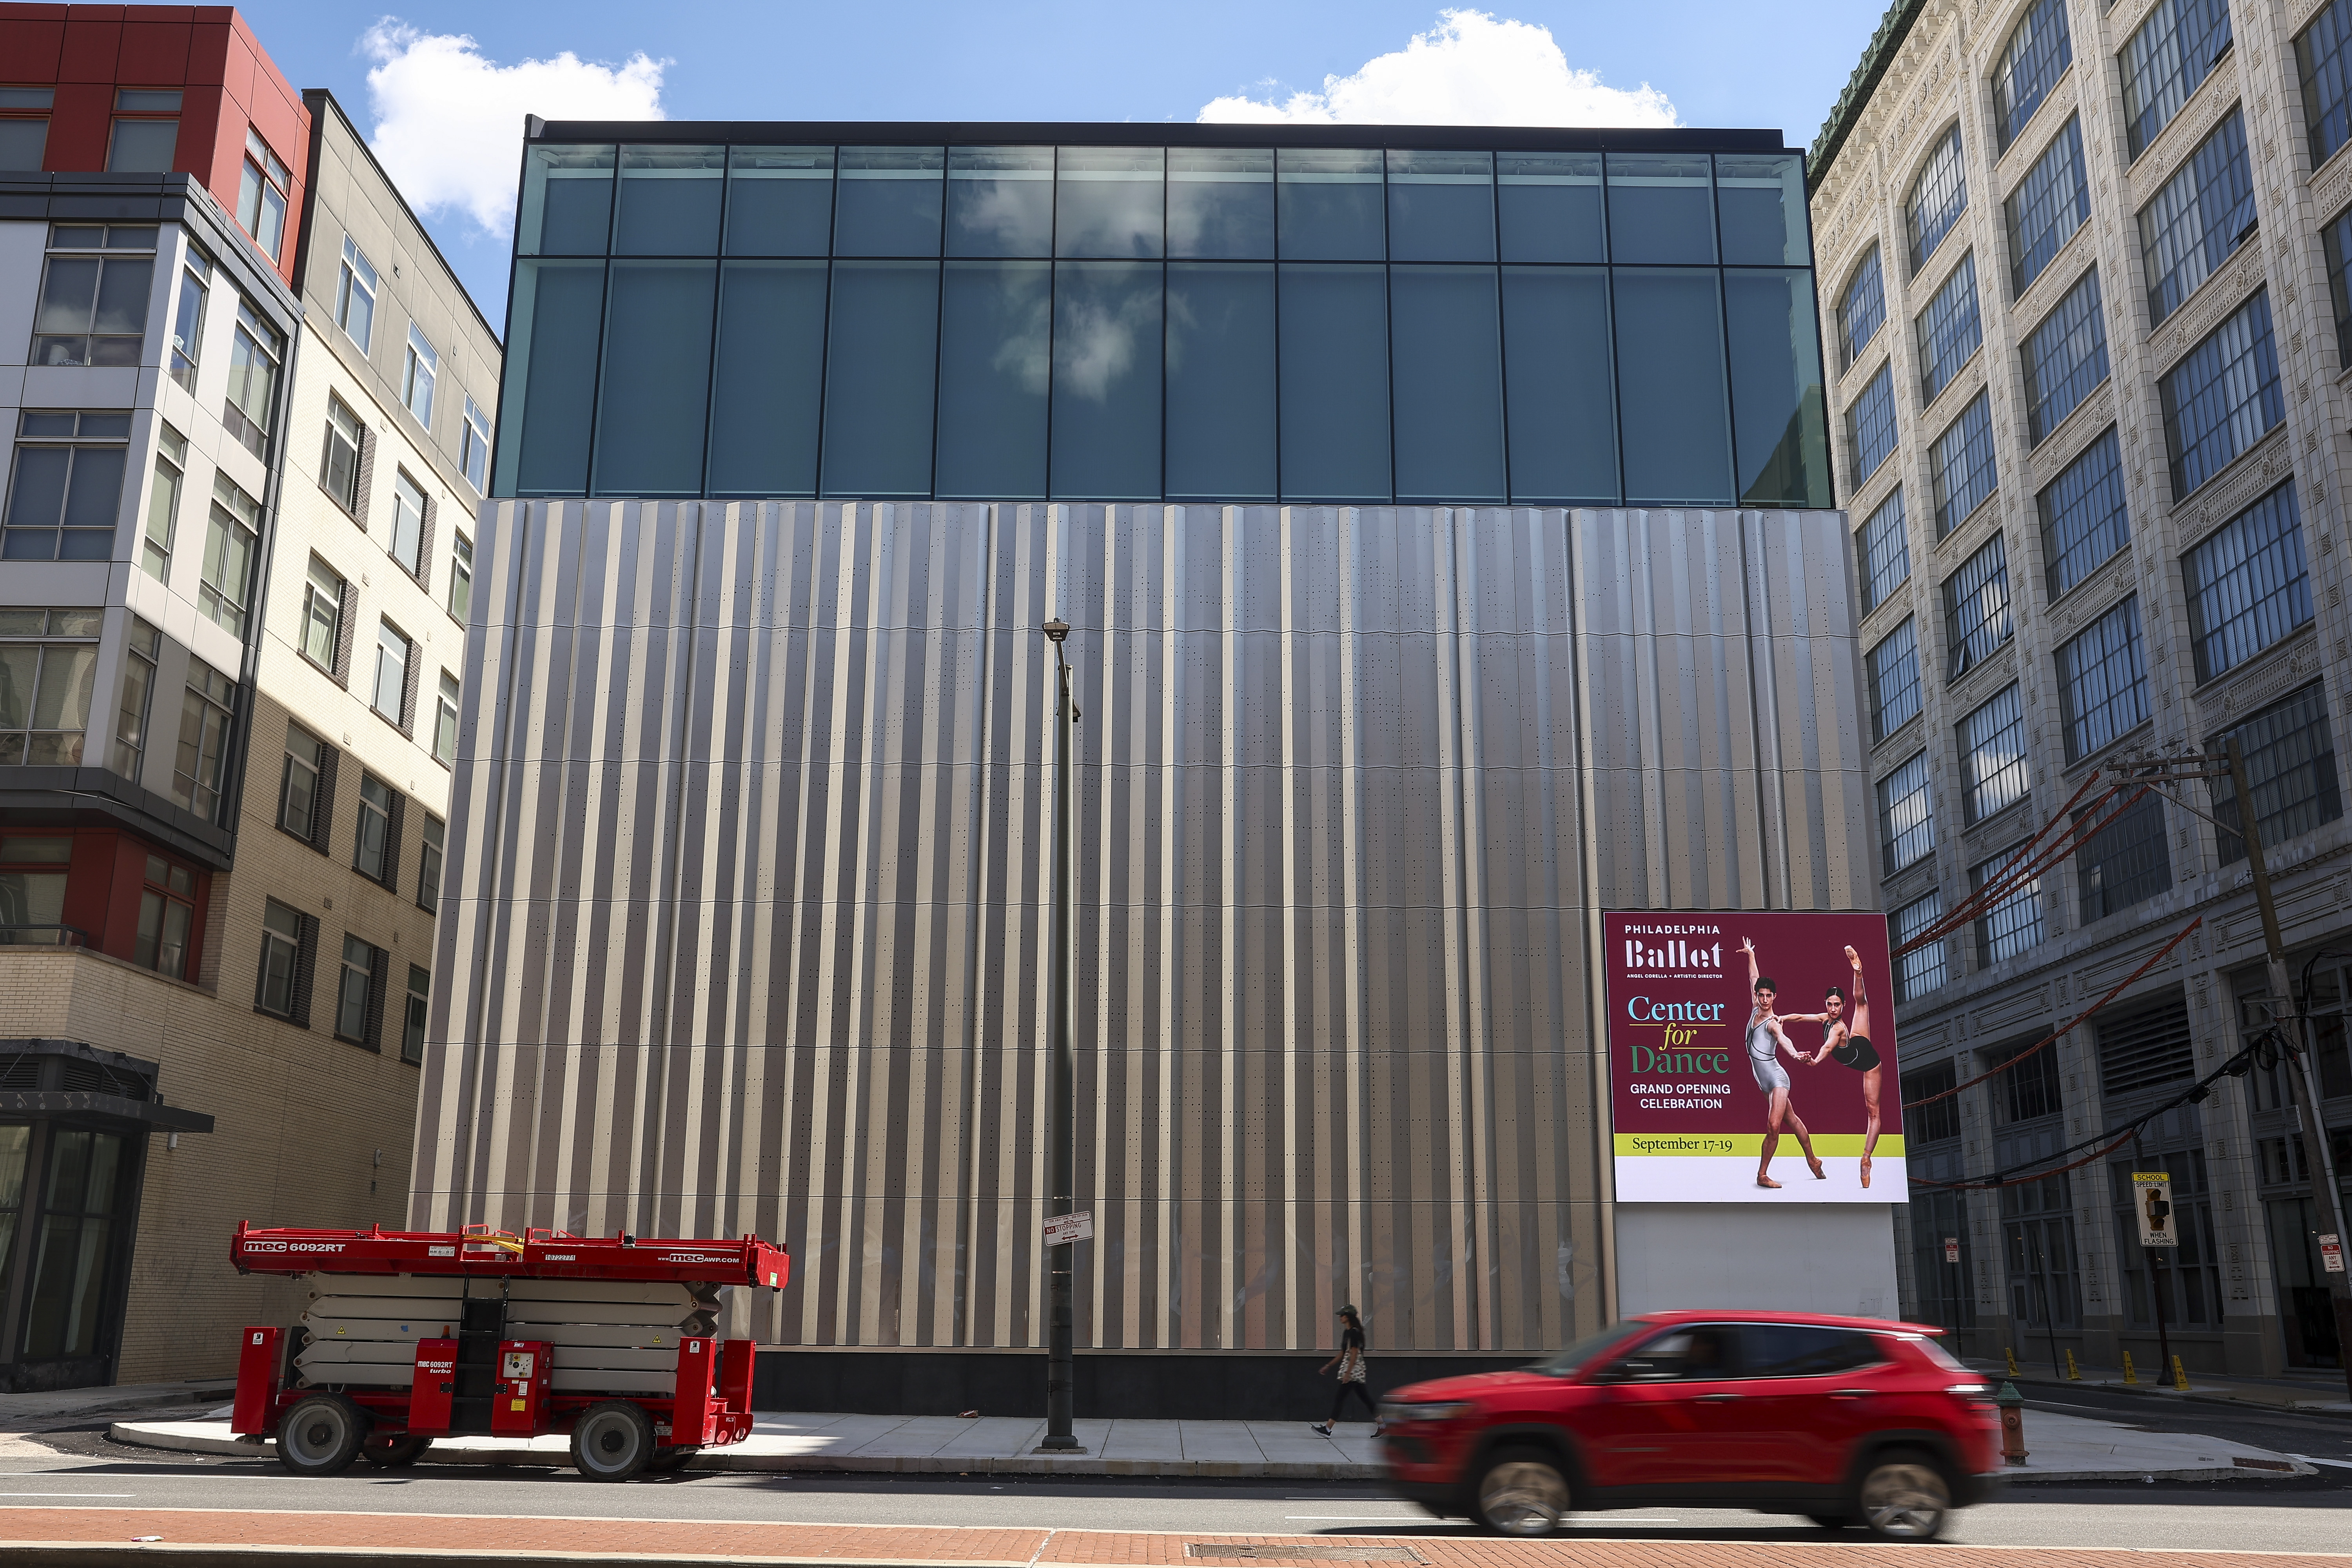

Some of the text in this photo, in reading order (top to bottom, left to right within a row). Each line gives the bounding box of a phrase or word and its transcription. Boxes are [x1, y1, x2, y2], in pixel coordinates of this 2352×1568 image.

[1625, 925, 1720, 934] PHILADELPHIA
[1626, 940, 1724, 968] Ballet
[1628, 996, 1725, 1021] Center
[1659, 1022, 1697, 1051] for
[1629, 1045, 1729, 1074] Dance
[1630, 1084, 1731, 1094] GRAND OPENING
[1640, 1099, 1722, 1109] CELEBRATION
[1633, 1137, 1732, 1153] September 17-19
[1056, 1223, 1082, 1232] STOPPING
[245, 1242, 346, 1252] mec 6092RT
